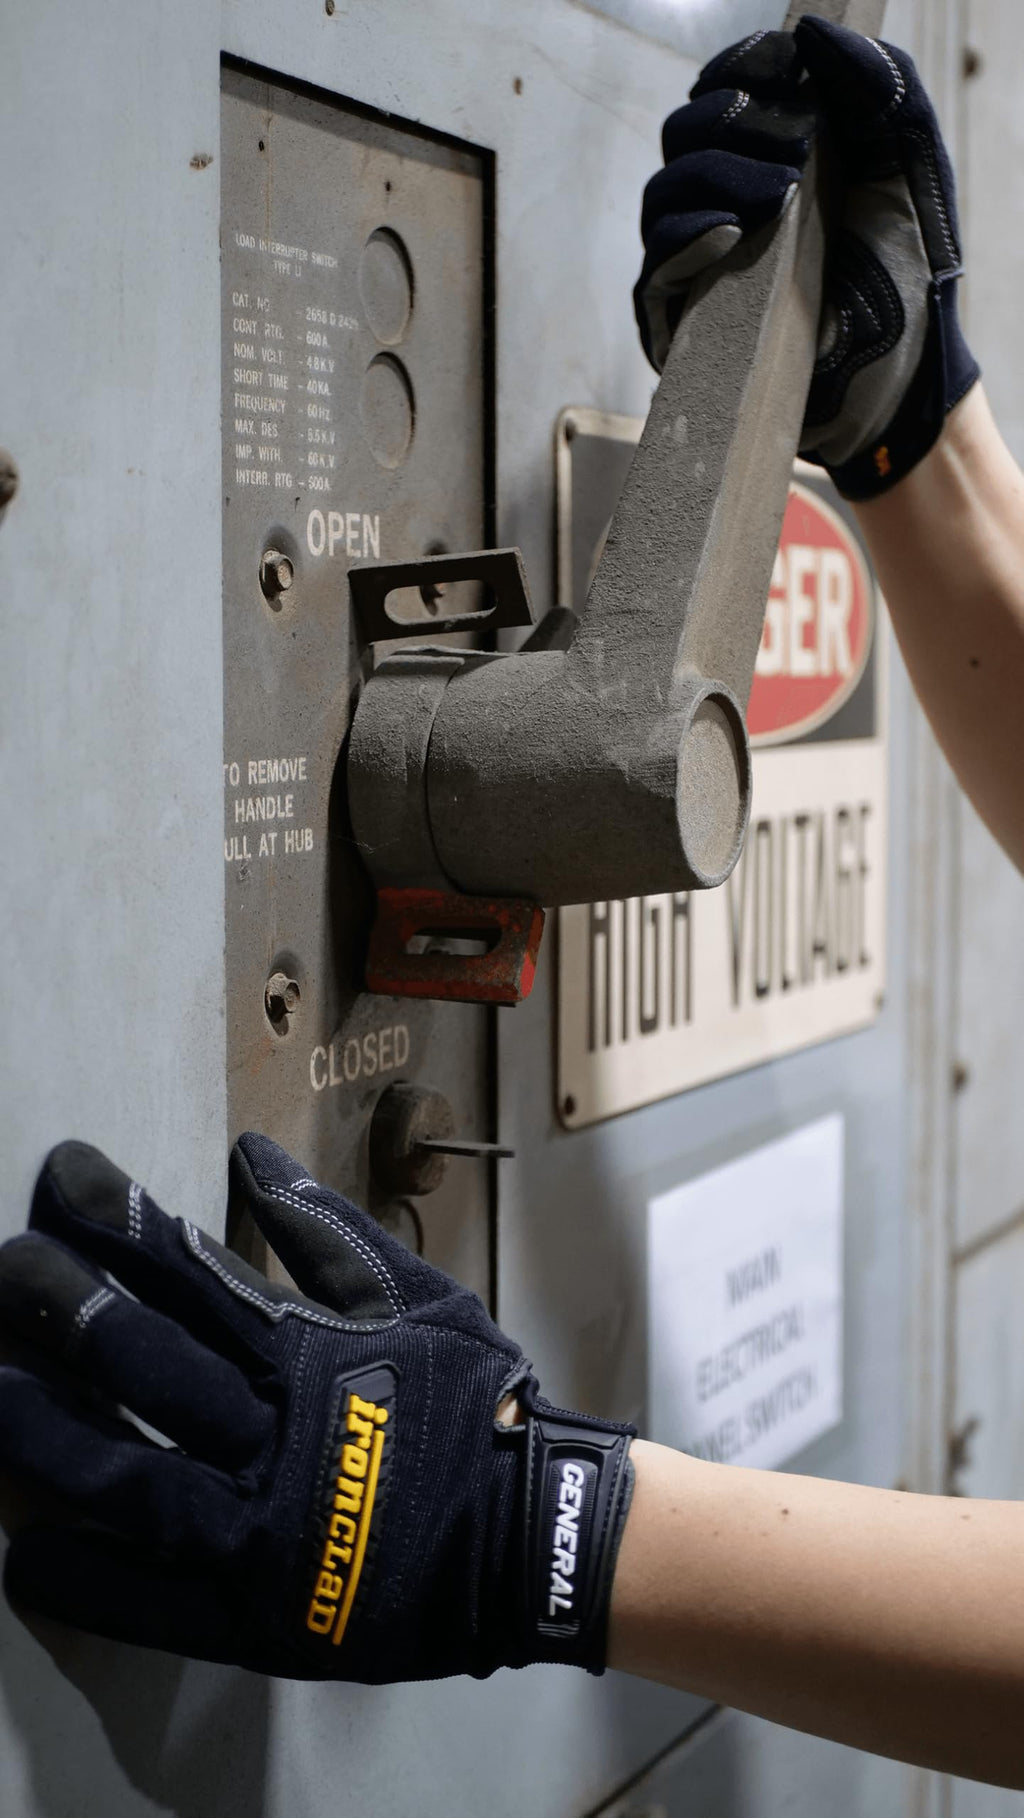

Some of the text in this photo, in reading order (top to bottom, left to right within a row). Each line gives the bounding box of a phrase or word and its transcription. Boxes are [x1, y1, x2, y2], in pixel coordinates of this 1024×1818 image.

[236, 233, 339, 269] LOAD INTERRUPTER SWITCH
[273, 259, 291, 275] TYPE
[233, 368, 263, 387] SHORT
[268, 373, 289, 390] TIME
[234, 393, 286, 414] FREQUENCY
[275, 472, 292, 488] RTG
[307, 509, 380, 559] OPEN
[248, 757, 307, 785] REMOVE
[235, 794, 294, 823] HANDLE
[224, 827, 314, 861] ULL AT HUB
[587, 804, 869, 1053] HIGH VOLTAGE
[310, 1025, 410, 1091] CLOSED
[549, 1462, 585, 1617] GENERAL
